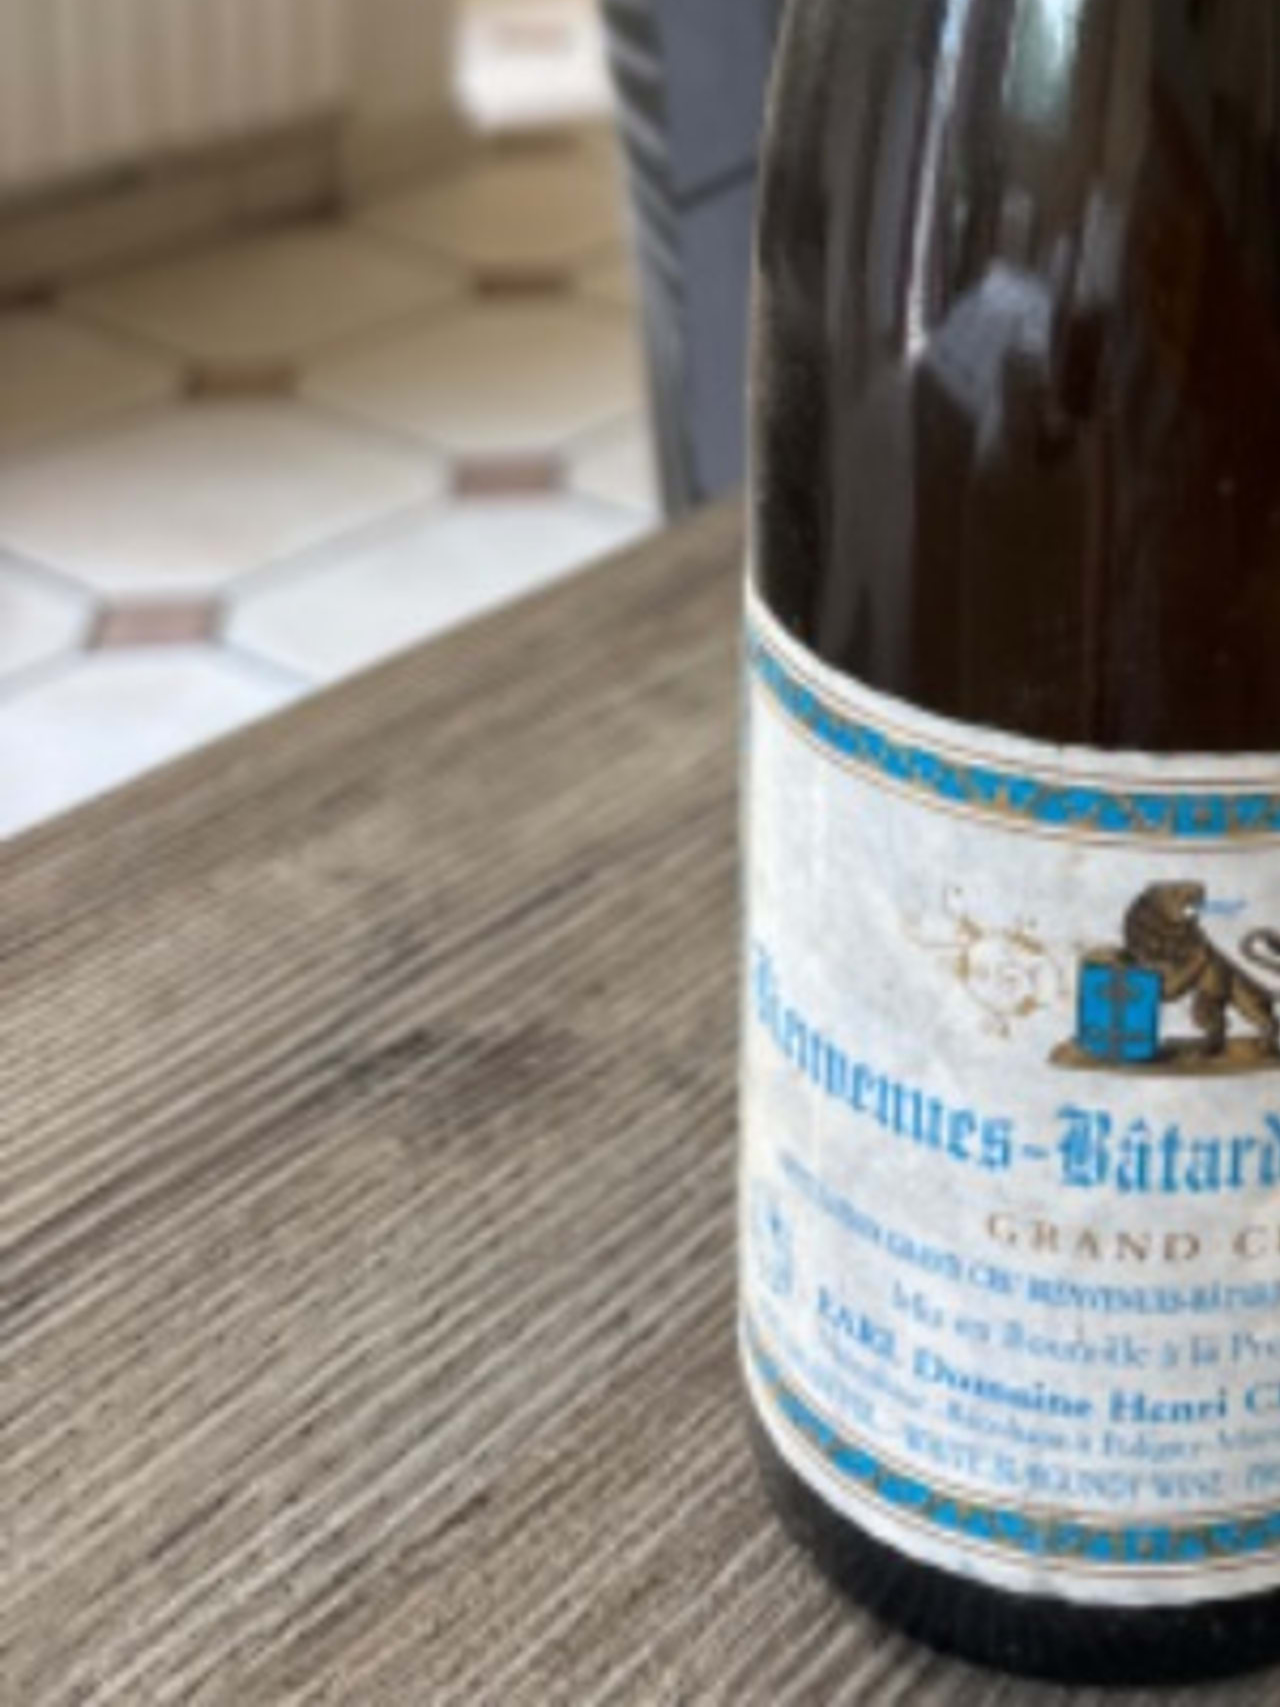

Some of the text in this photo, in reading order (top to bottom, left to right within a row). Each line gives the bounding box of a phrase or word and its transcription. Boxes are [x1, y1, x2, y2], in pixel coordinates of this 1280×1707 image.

[986, 1210, 1202, 1264] GRAND
[913, 1346, 1093, 1418] Domaine
[1109, 1384, 1227, 1424] Henri
